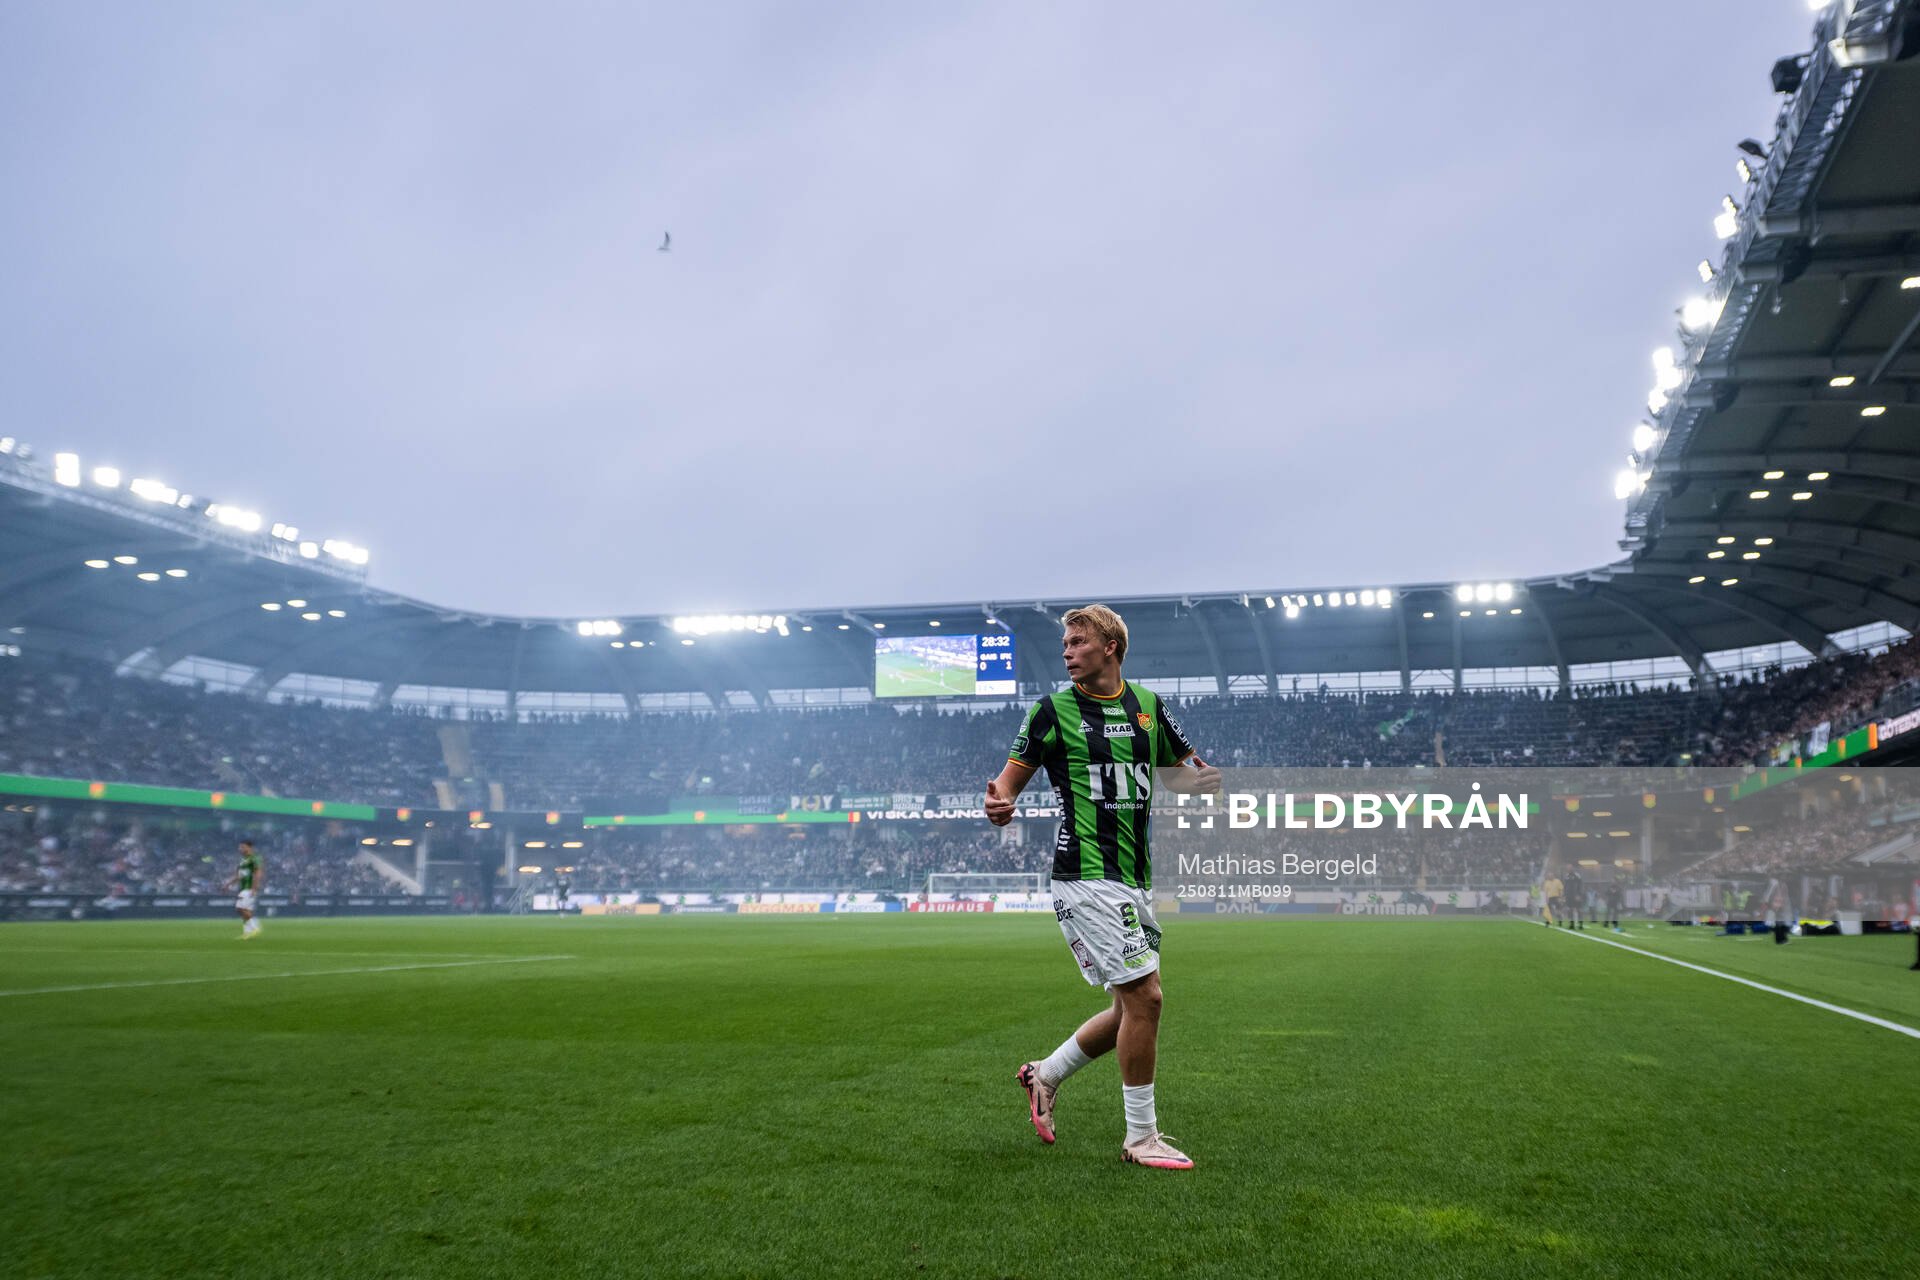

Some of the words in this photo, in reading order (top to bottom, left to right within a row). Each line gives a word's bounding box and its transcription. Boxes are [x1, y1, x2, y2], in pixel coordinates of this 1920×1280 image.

[982, 636, 1010, 647] 28:32
[980, 661, 987, 671] 0
[1006, 660, 1012, 670] 1
[1106, 725, 1132, 733] SKAB
[1086, 763, 1151, 801] ITS
[1104, 801, 1144, 810] indeship.se
[866, 811, 883, 820] VI
[885, 810, 921, 820] SKA
[923, 809, 988, 819] SJUNG
[740, 903, 817, 913] BYGGMAX
[918, 902, 986, 912] BAUHAUS
[1215, 903, 1265, 914] DAHL
[1342, 903, 1429, 915] OPTIMERA
